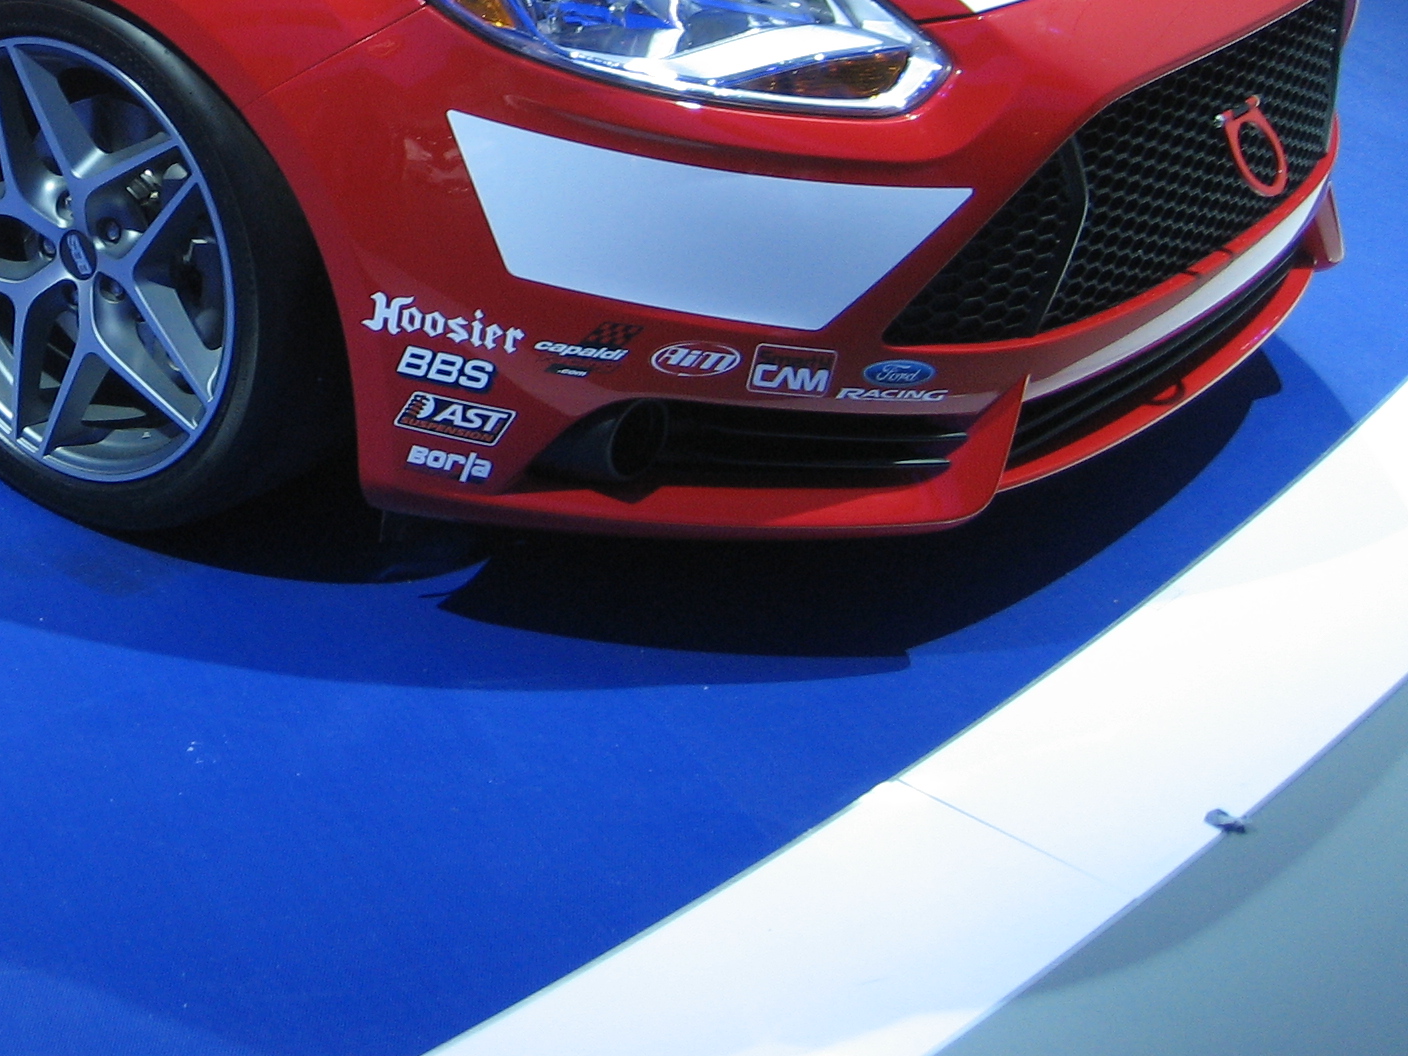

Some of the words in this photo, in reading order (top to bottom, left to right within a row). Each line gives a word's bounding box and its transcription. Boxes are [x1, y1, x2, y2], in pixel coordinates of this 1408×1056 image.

[361, 292, 525, 355] Hoosier
[534, 341, 629, 361] capaldi
[396, 345, 495, 390] BBS
[752, 363, 830, 393] CAM
[834, 387, 950, 402] RACING
[433, 403, 510, 432] AST
